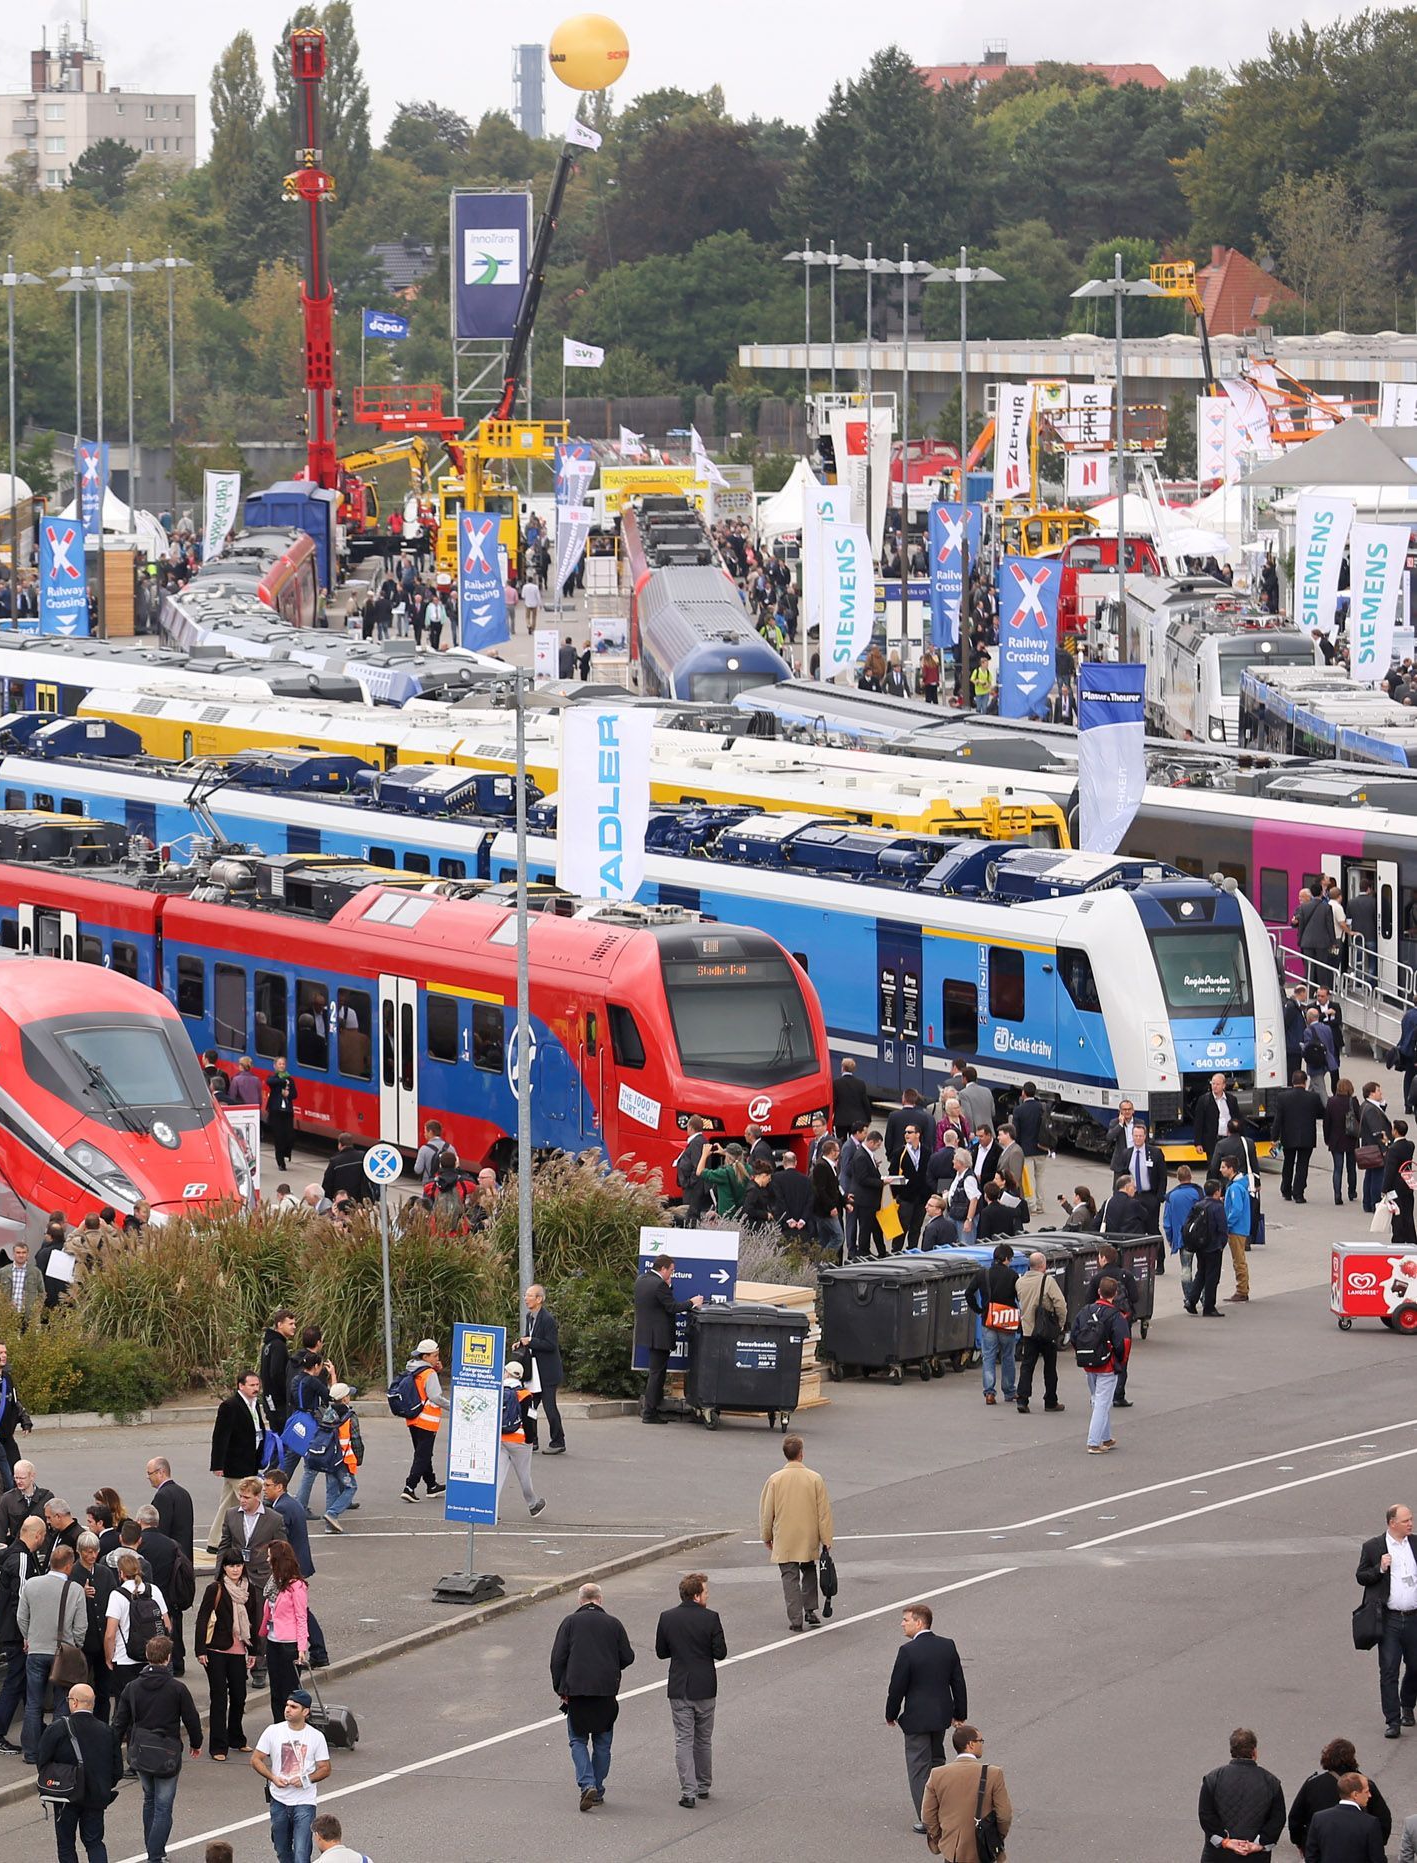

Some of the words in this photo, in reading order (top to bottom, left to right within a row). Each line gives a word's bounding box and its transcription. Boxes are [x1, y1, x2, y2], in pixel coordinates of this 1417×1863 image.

[471, 233, 514, 243] InnoTrans
[1302, 511, 1334, 625] SIEMENS
[464, 579, 496, 590] Railway
[46, 586, 84, 598] Railway
[464, 589, 500, 601] Crossing
[45, 598, 86, 609] Crossing
[833, 537, 855, 663] SIEMENS
[1358, 543, 1388, 663] SIEMENS
[1008, 636, 1048, 651] Railway
[1006, 651, 1050, 665] Crossing
[330, 1001, 337, 1022] 2
[463, 1028, 468, 1050] 1
[1010, 1033, 1030, 1053] České
[1031, 1038, 1052, 1061] dráhy
[1196, 1059, 1212, 1068] 640
[1215, 1058, 1239, 1067] 005-5
[621, 1088, 632, 1099] THE
[620, 1099, 636, 1115] FLIRT
